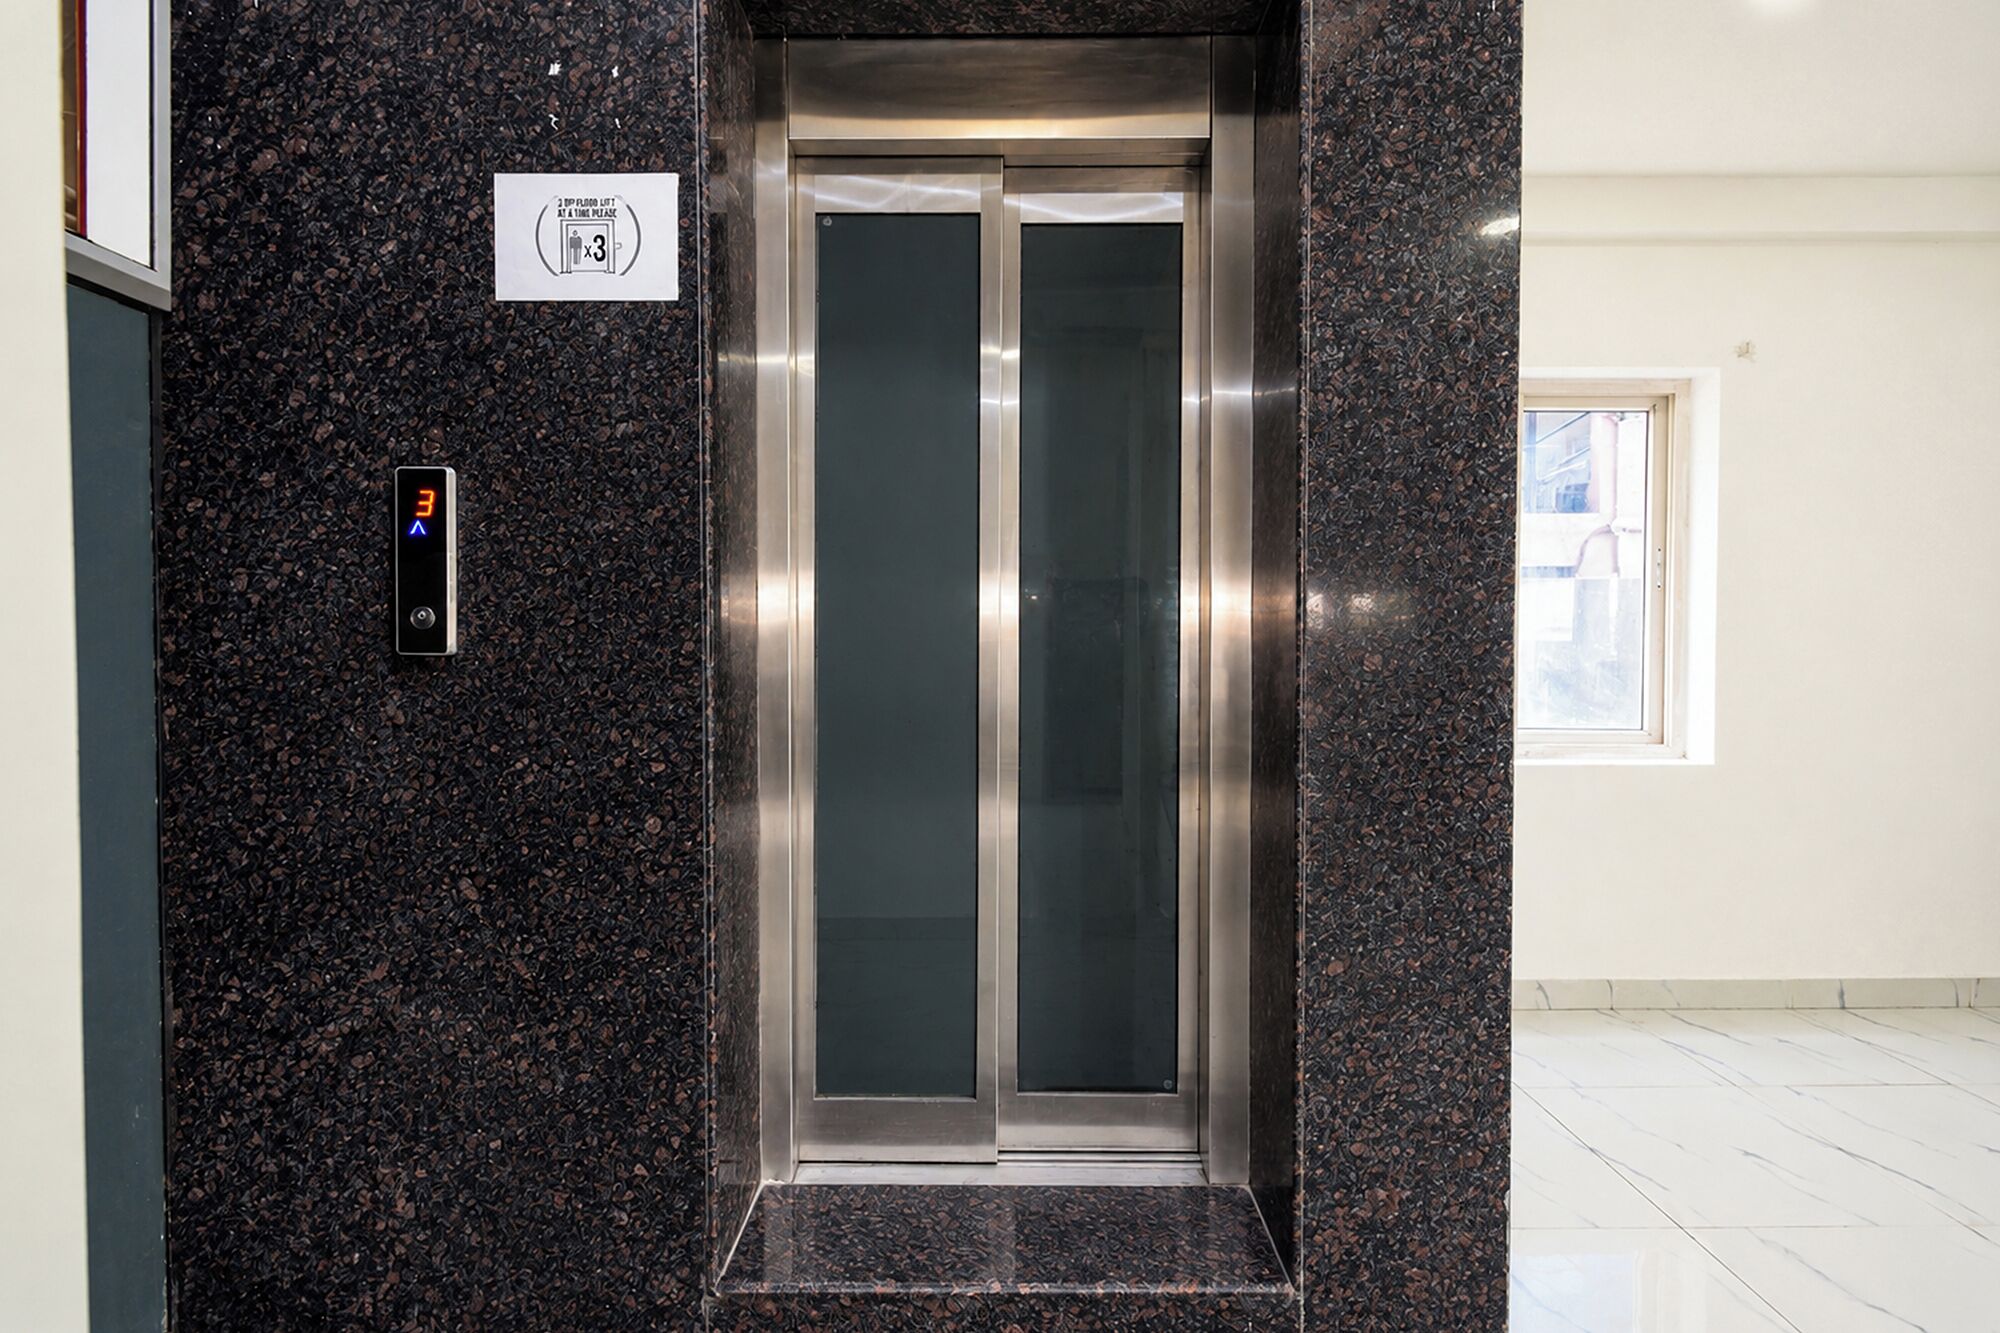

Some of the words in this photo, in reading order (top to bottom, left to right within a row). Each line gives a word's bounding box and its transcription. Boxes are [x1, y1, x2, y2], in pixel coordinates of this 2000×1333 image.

[568, 208, 573, 218] A
[592, 208, 617, 218] PLEASE
[415, 489, 435, 517] 3
